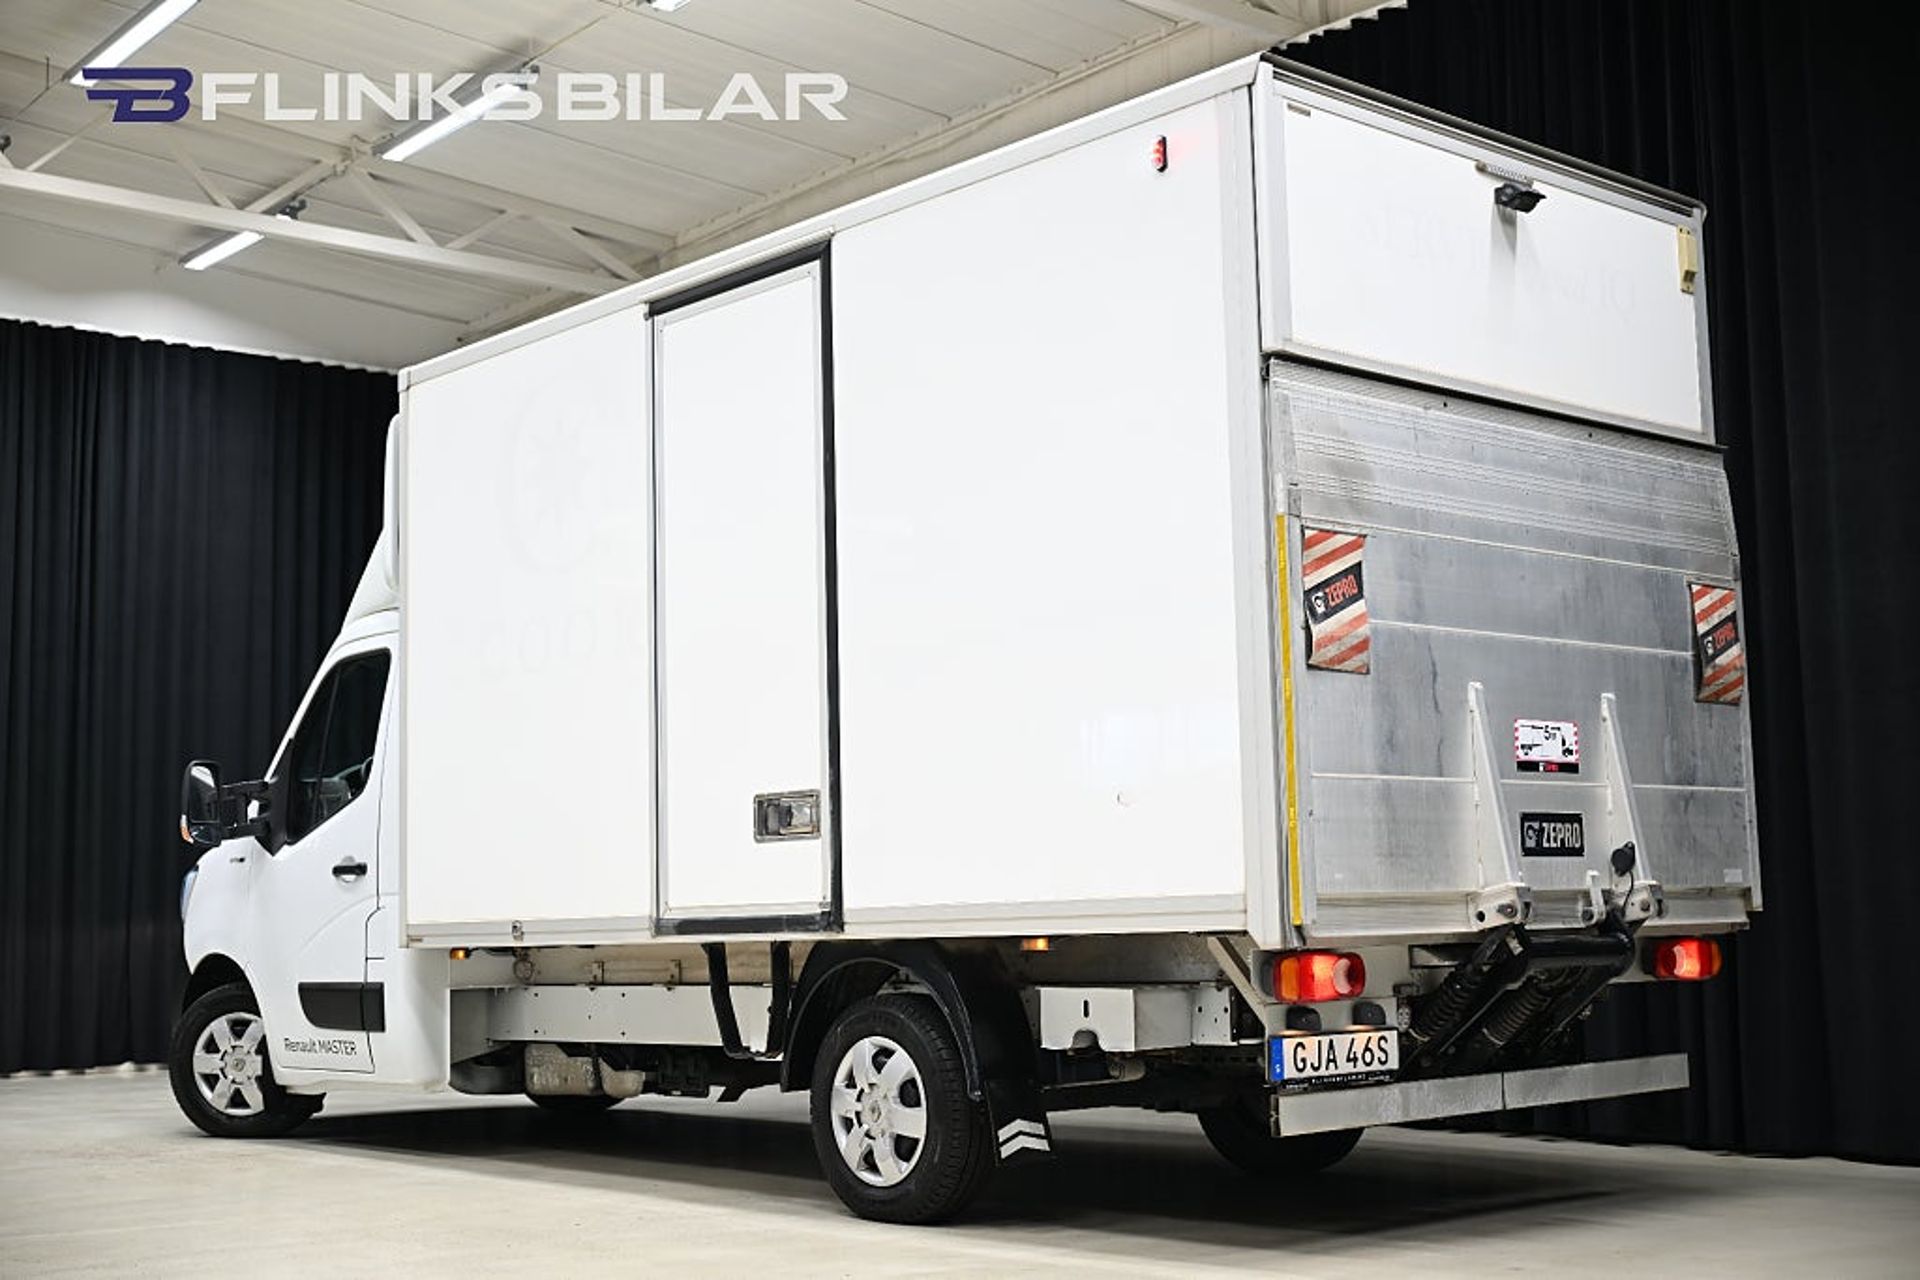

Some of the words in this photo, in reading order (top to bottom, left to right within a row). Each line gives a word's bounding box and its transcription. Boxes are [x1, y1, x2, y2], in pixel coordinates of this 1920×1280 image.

[1324, 574, 1359, 607] ZEPRO
[1541, 822, 1582, 848] ZEPRO
[283, 1037, 317, 1054] Renault
[318, 1039, 357, 1056] MASTER
[1293, 1038, 1339, 1073] GJA
[1346, 1035, 1389, 1068] 46S
